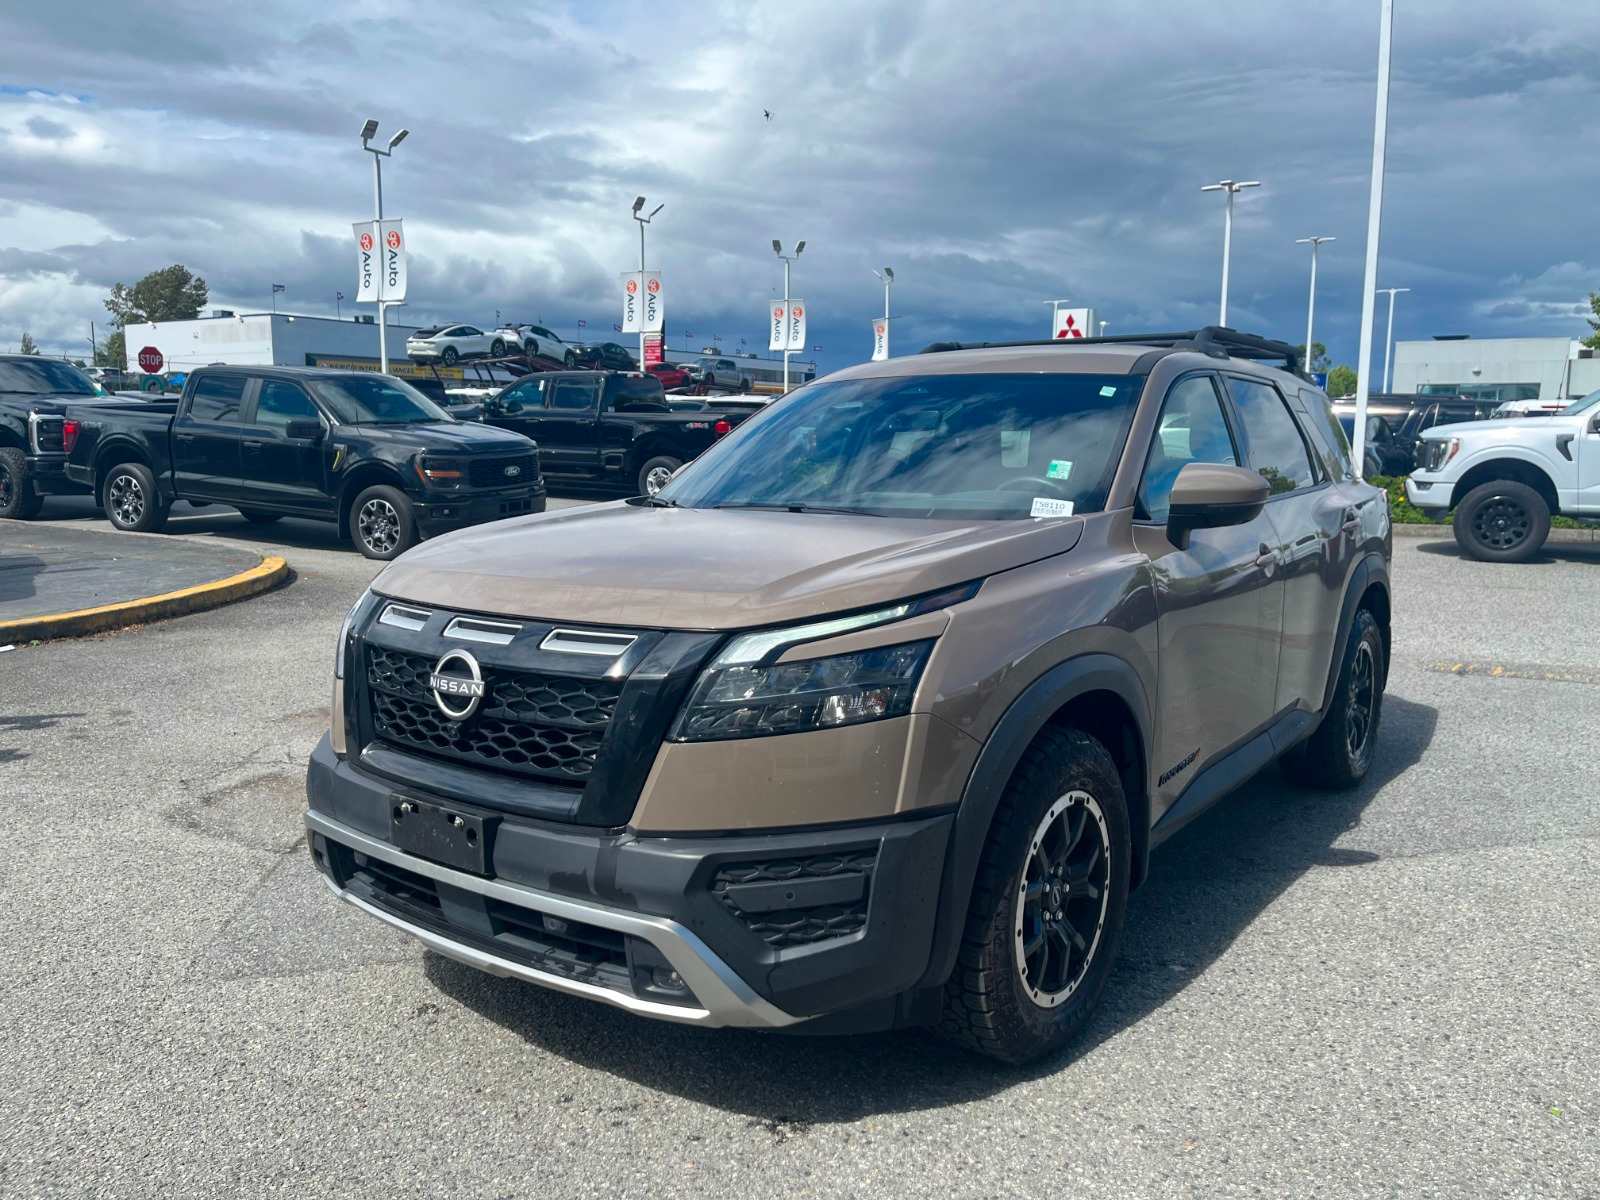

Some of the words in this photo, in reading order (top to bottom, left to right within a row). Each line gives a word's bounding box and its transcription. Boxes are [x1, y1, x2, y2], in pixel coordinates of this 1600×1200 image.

[362, 251, 371, 288] Auto
[388, 249, 398, 287] Auto
[648, 293, 656, 322] Auto
[140, 354, 161, 365] STOP
[430, 676, 482, 695] NISSAN
